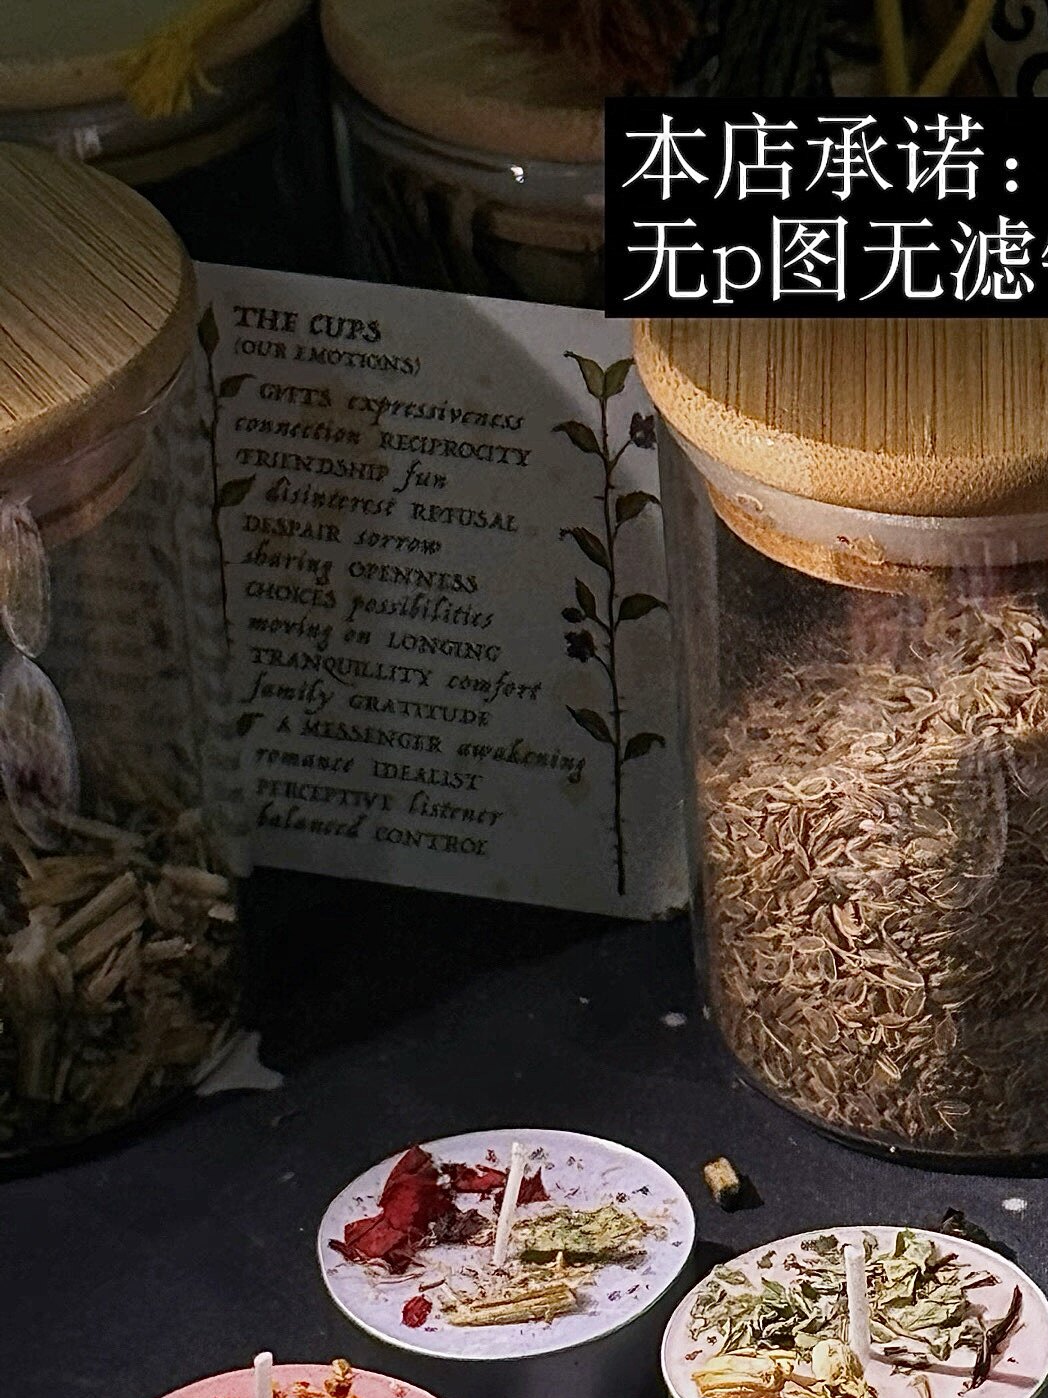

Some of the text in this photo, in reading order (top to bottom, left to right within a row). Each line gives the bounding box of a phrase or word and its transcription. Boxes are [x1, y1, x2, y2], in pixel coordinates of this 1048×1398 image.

[233, 305, 382, 342] THE CUPS
[234, 340, 422, 376] (OUR EMOTIONS)
[260, 383, 525, 431] GIFTS expressiveness
[235, 416, 532, 467] connection RECIPROCITY
[235, 448, 449, 493] FRIENDSHIP fun
[265, 476, 519, 532] disinterest REFUSAL
[242, 514, 441, 554] DESPAIR sorrow
[242, 539, 478, 593] sharing OPENNESS
[245, 581, 494, 631] CHOICES possibilities
[248, 616, 501, 663] moving on LONGING
[250, 647, 542, 701] TRANQUILLITY comfort
[245, 671, 492, 727] family GRATITUDE
[255, 748, 483, 790] romance IDEALIST
[300, 719, 441, 754] MESSENGER
[457, 738, 586, 784] awakening
[256, 802, 488, 856] balanced CONTROL
[409, 790, 503, 827] listener
